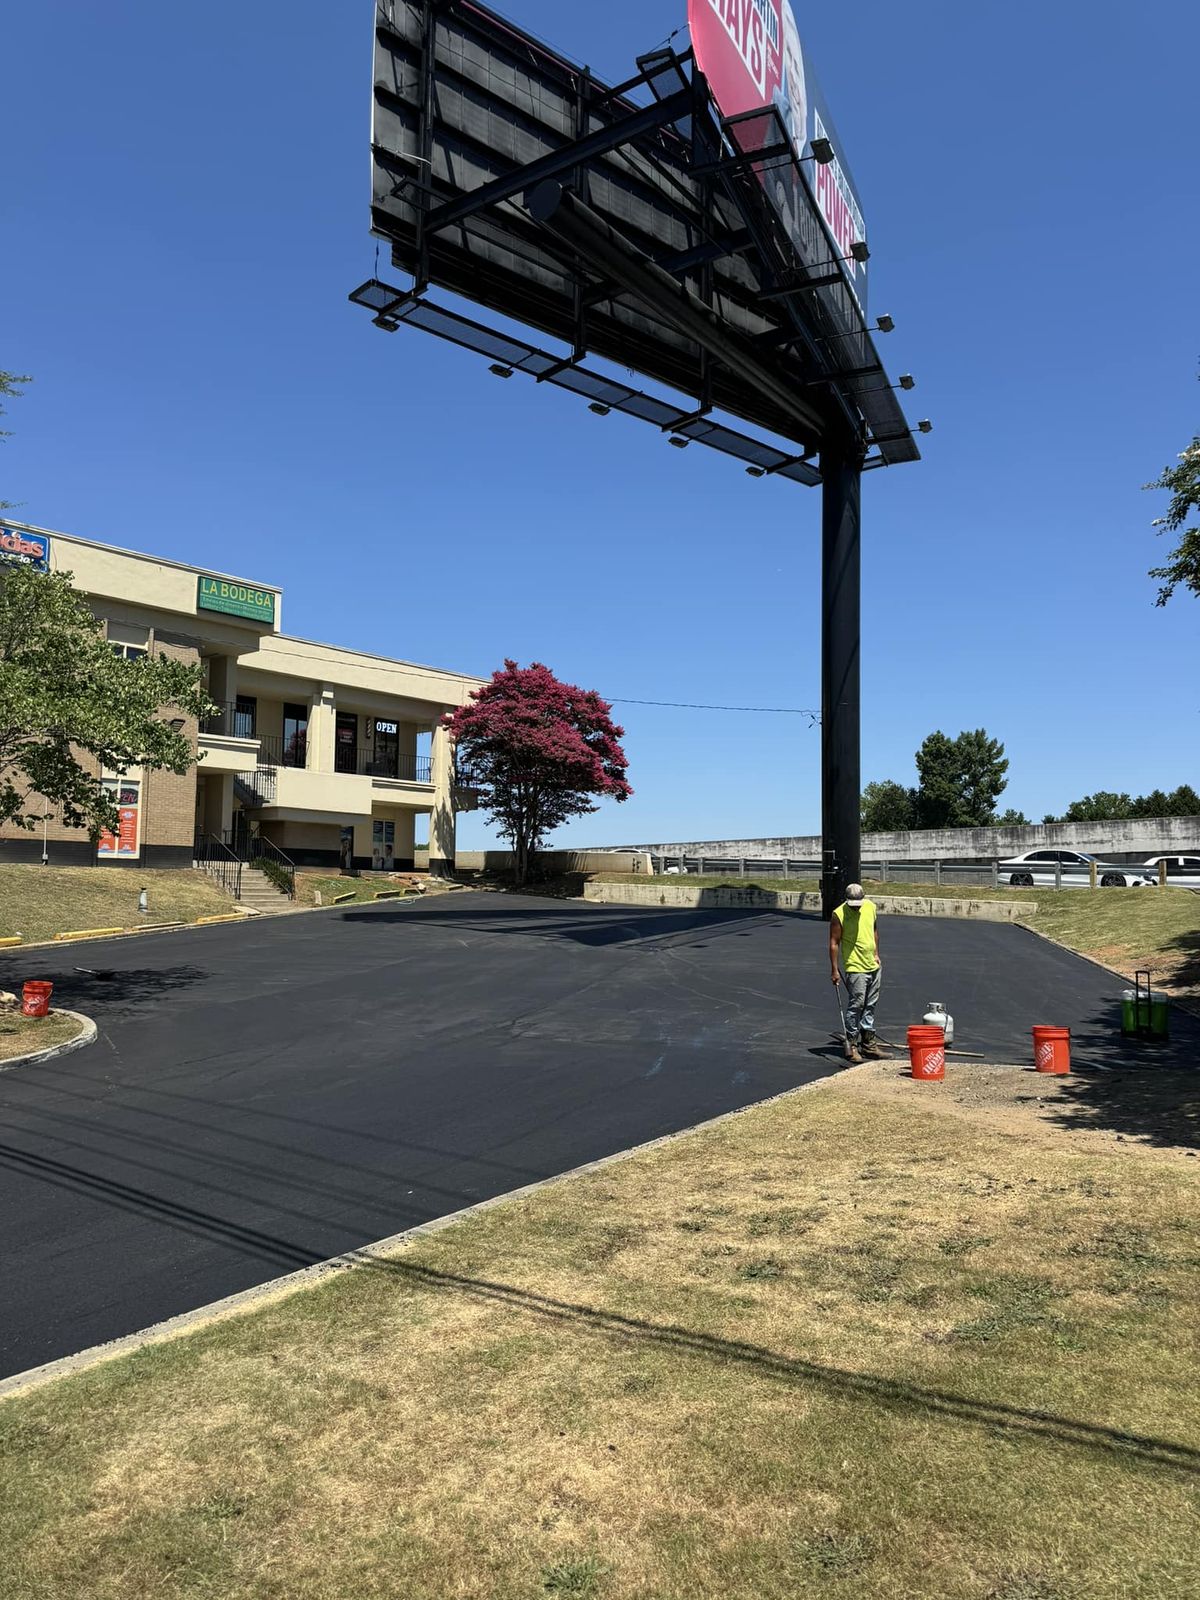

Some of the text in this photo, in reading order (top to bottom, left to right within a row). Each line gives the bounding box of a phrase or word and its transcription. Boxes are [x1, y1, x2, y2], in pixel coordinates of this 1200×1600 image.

[713, 0, 765, 86] AYS
[817, 160, 857, 279] POWER
[202, 579, 272, 608] LA BODEGA
[376, 721, 397, 734] OPEN
